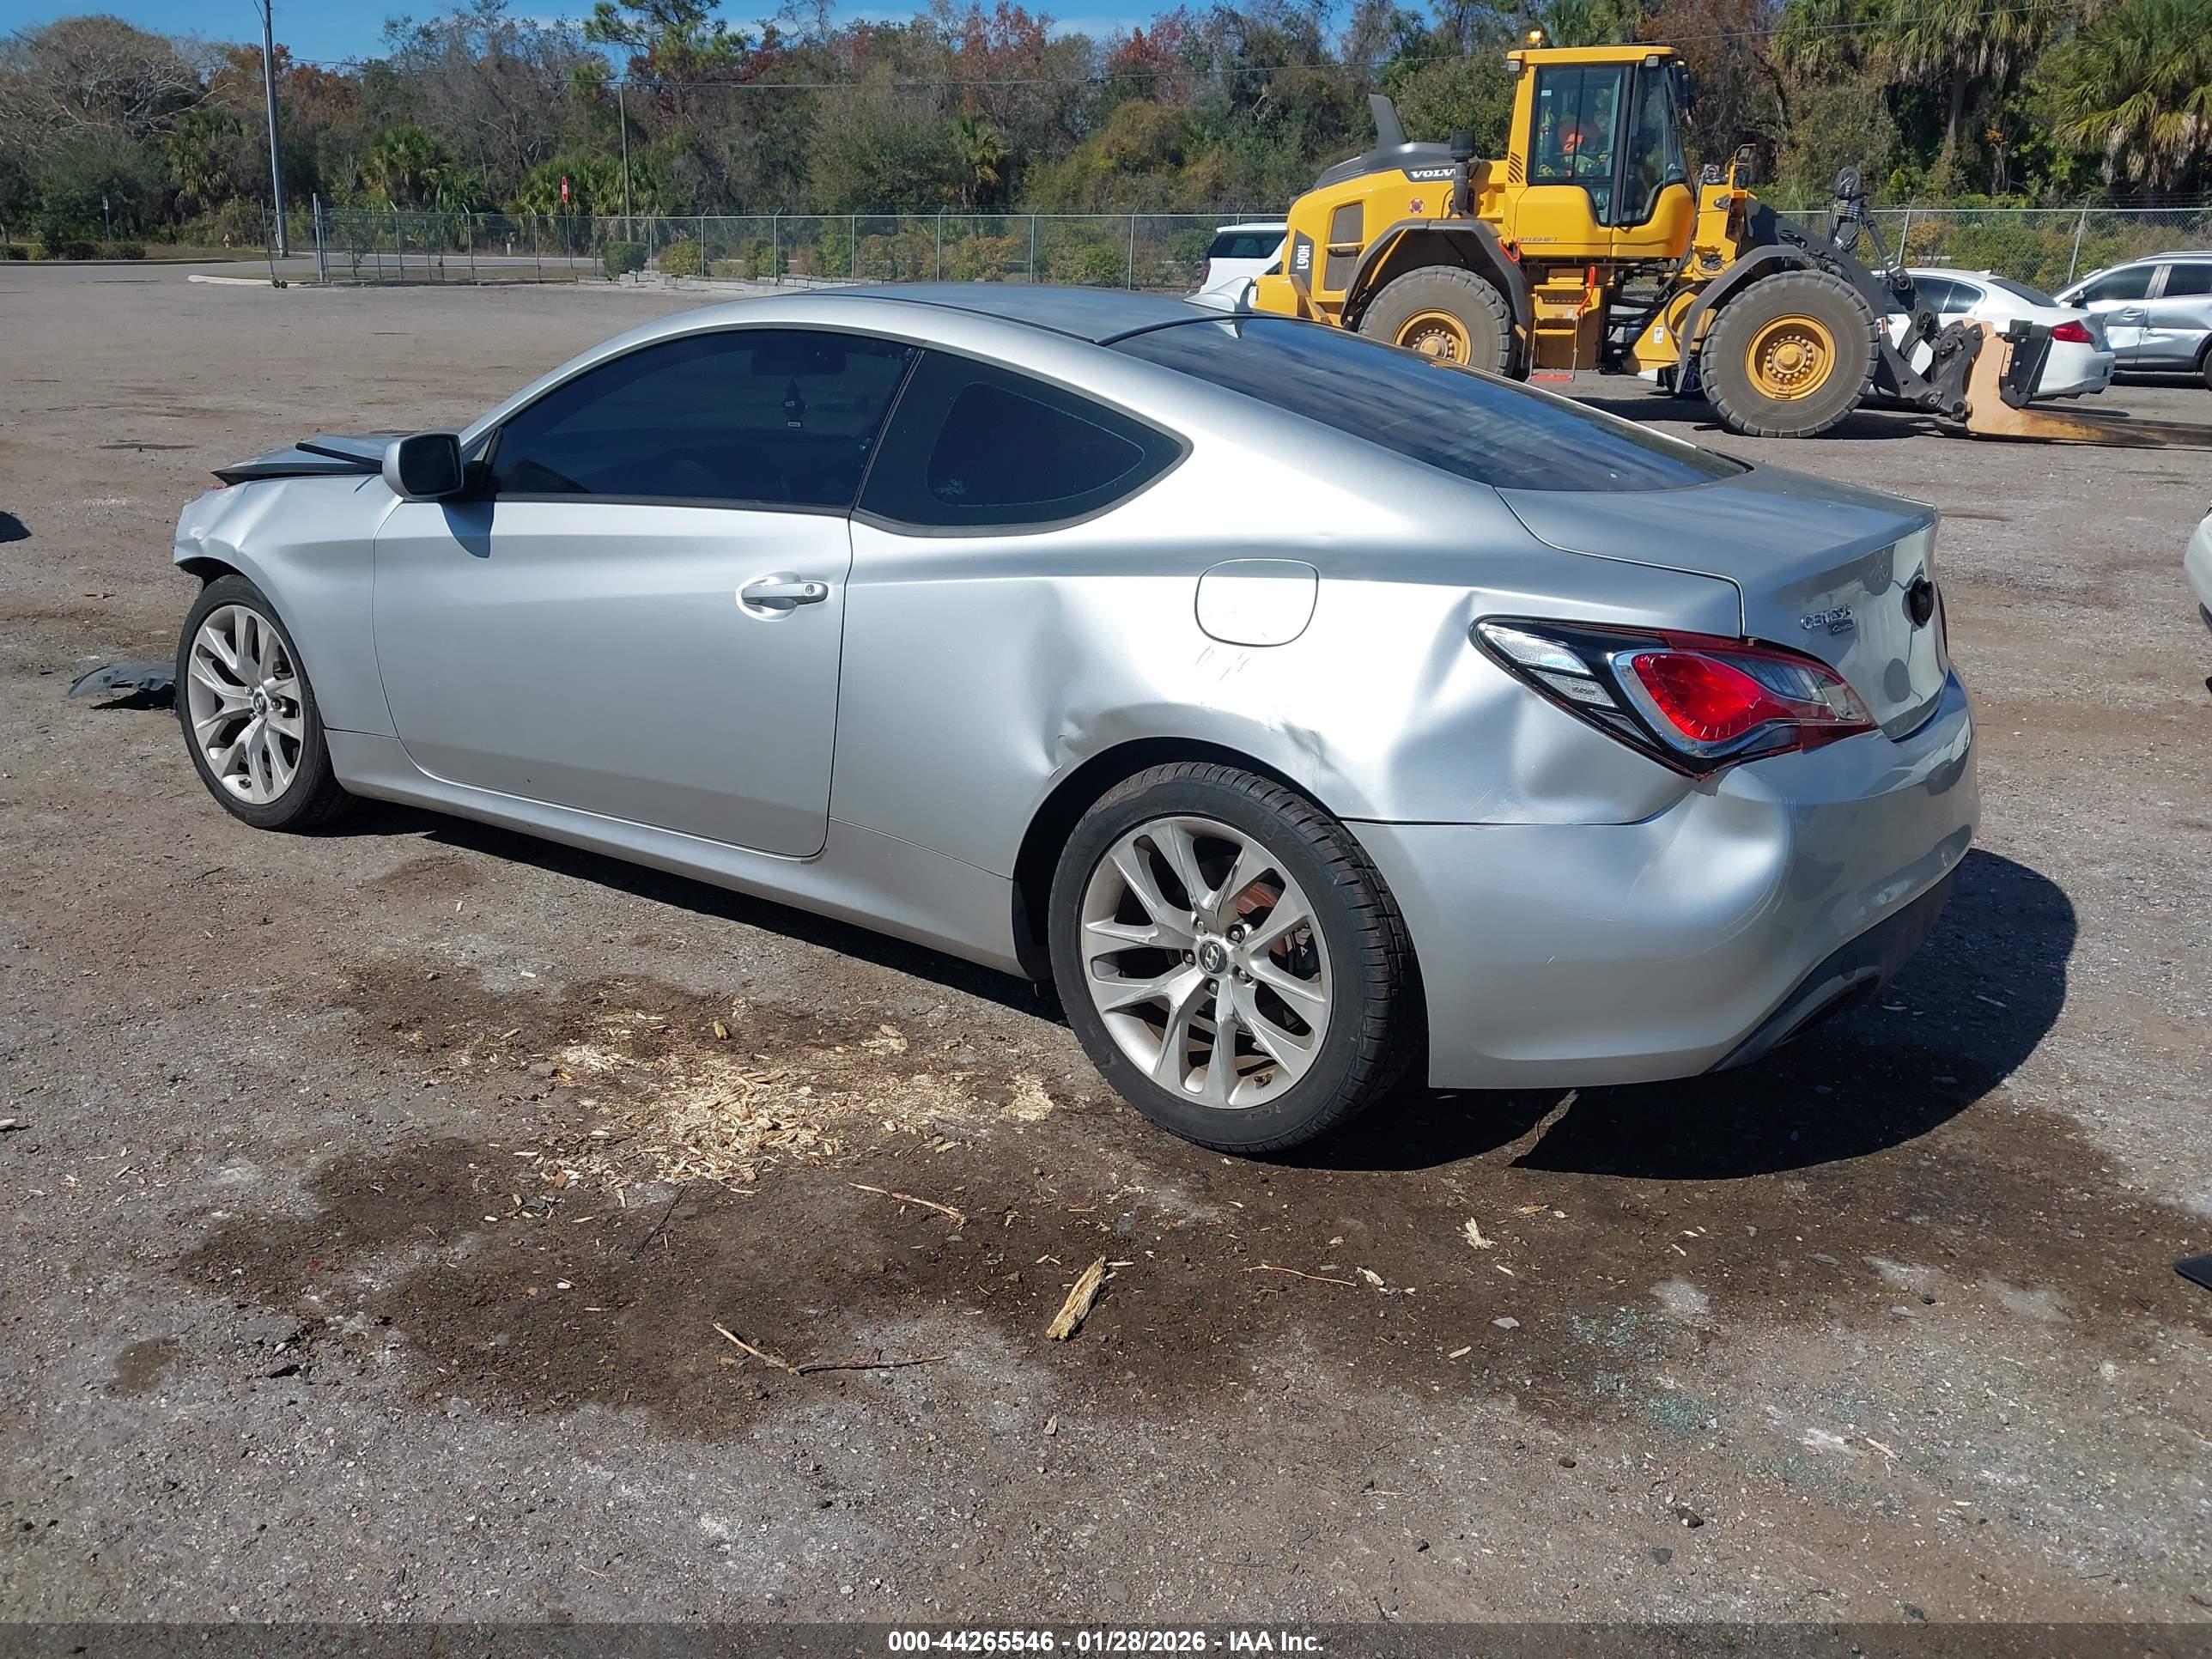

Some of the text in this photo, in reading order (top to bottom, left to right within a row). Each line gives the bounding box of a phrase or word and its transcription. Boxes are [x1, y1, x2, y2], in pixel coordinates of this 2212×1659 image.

[1410, 168, 1456, 179] VOLV
[1297, 245, 1310, 270] L90H
[1803, 604, 1854, 629] GENESIS
